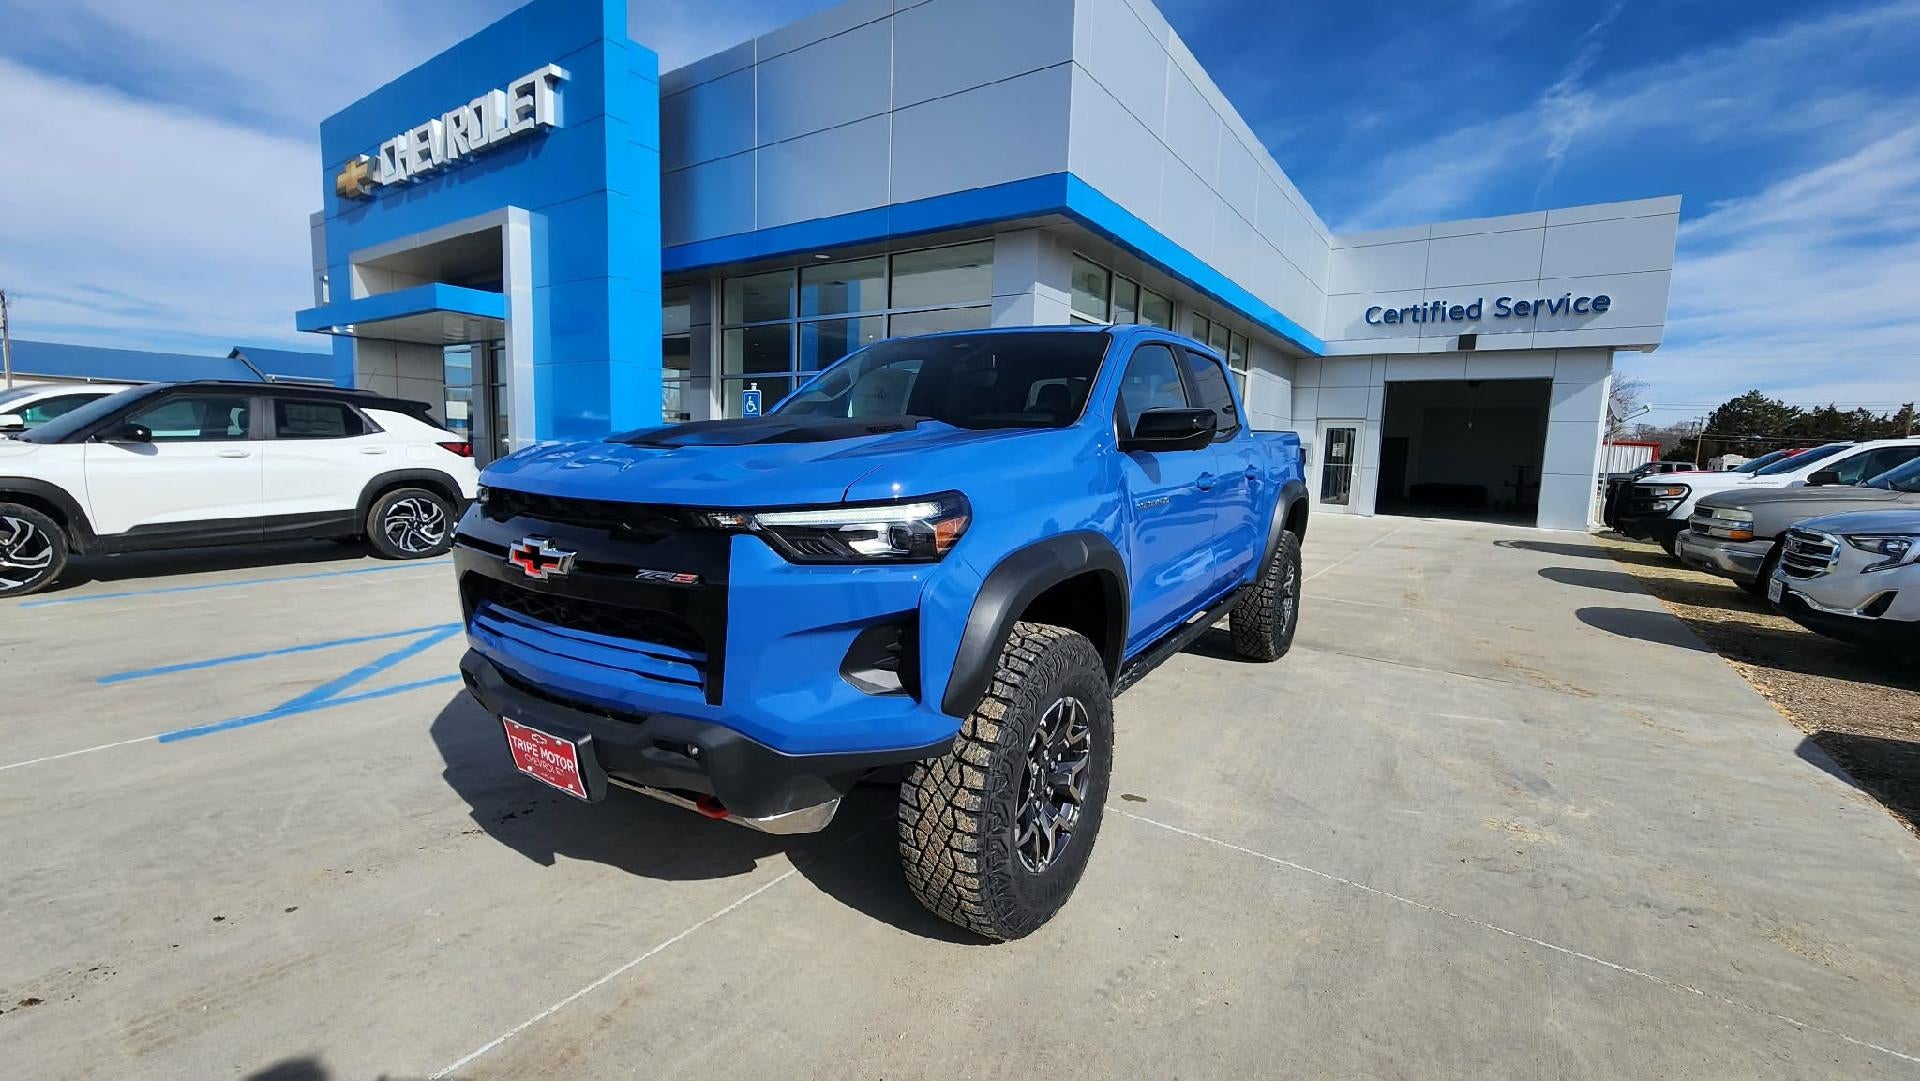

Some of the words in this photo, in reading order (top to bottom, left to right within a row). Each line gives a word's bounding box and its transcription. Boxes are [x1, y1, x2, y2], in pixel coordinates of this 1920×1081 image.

[371, 63, 571, 186] CHEVROLET
[1365, 298, 1483, 326] Certified
[1494, 293, 1611, 319] Service
[511, 735, 539, 757] TRIPE
[540, 747, 575, 773] MOTOR
[524, 754, 564, 776] CHEVROLET
